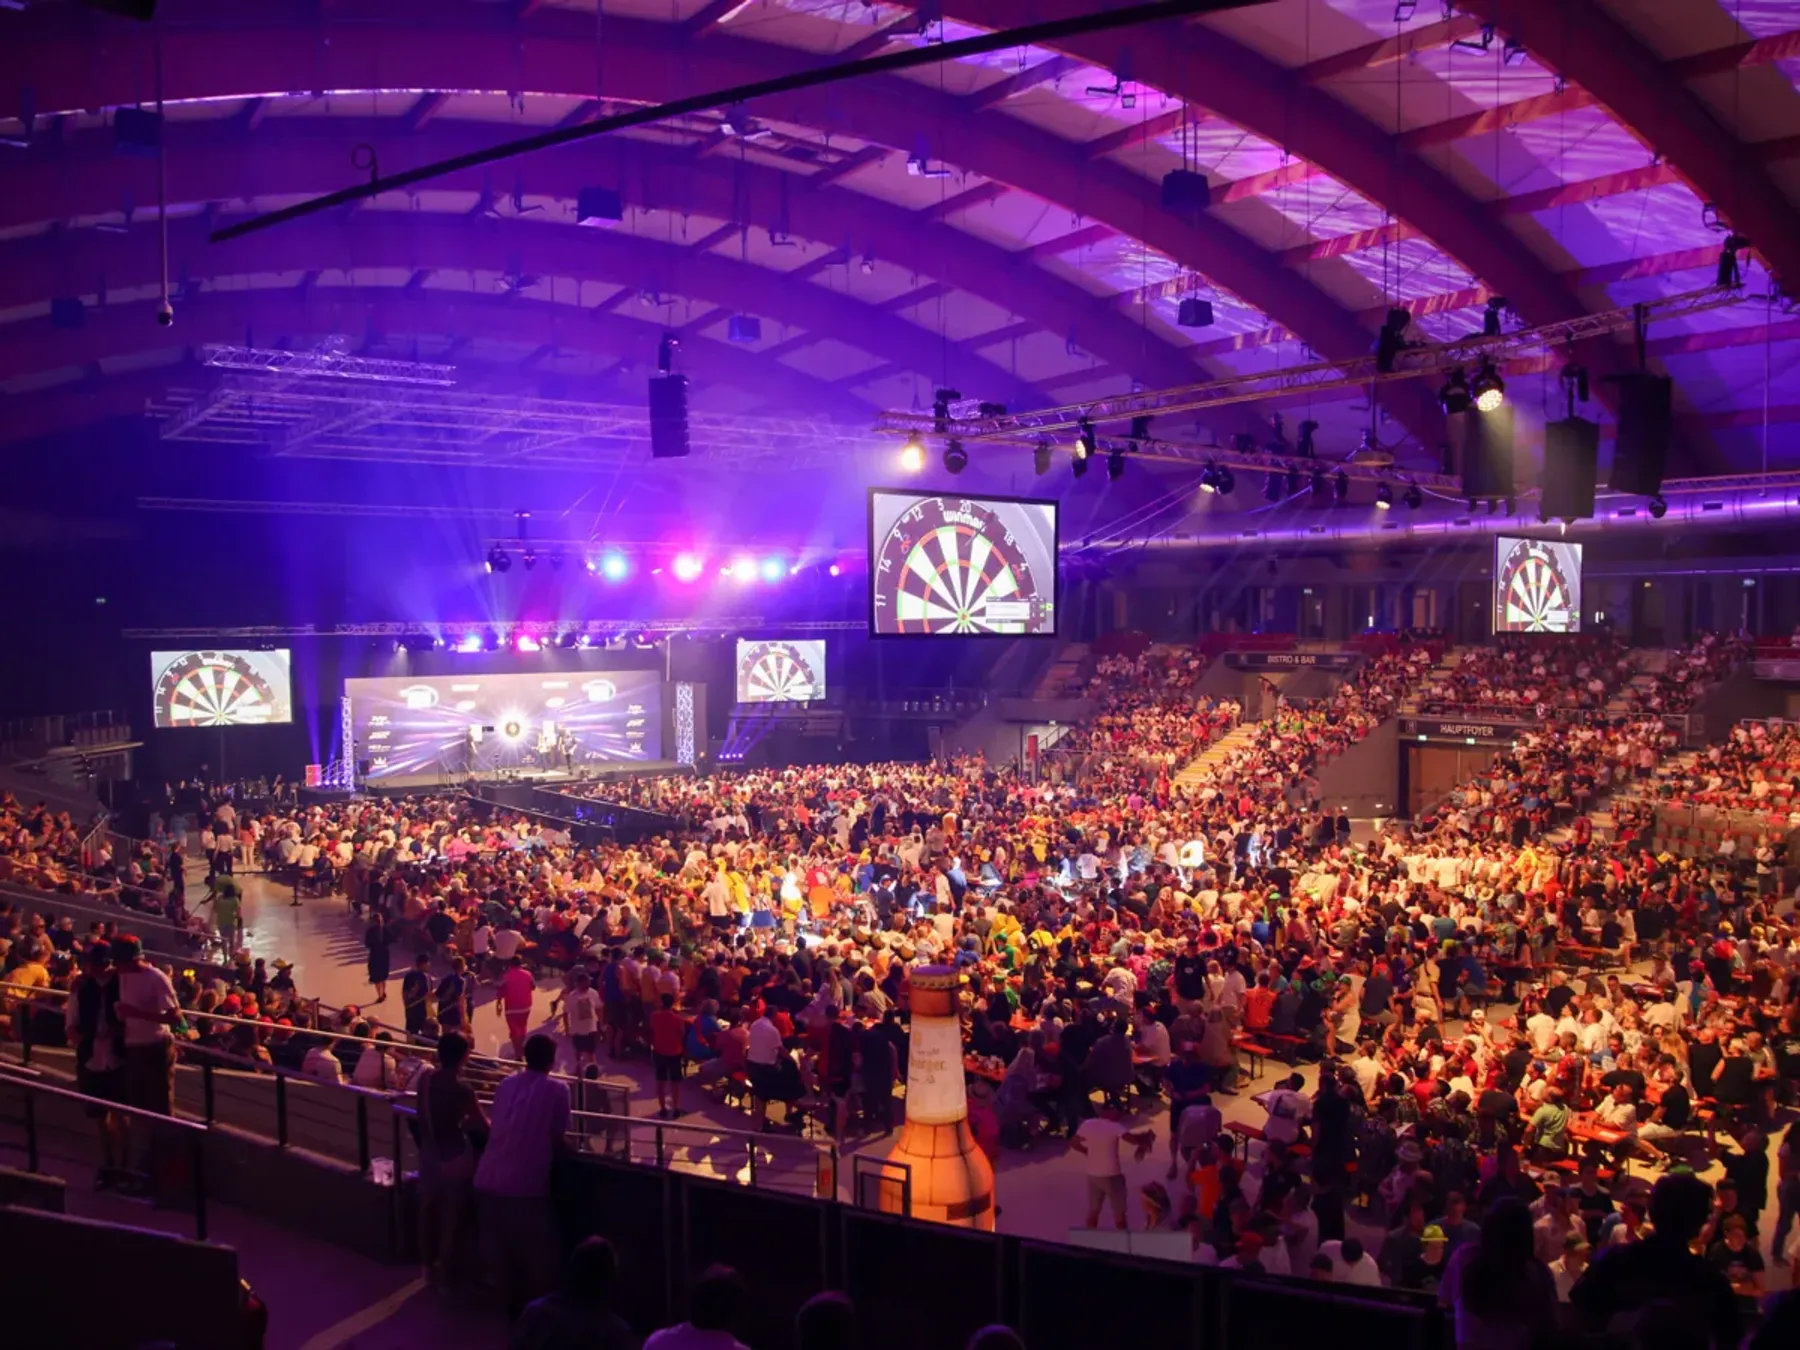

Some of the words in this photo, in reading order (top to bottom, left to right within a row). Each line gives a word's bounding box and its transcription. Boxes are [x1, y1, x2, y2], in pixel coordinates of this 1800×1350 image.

[960, 499, 972, 513] 20
[911, 506, 924, 522] 12
[1003, 530, 1014, 546] 18
[1267, 655, 1293, 664] BISTRO
[1301, 655, 1316, 664] BAR
[1440, 724, 1494, 736] HAUPTFOYER
